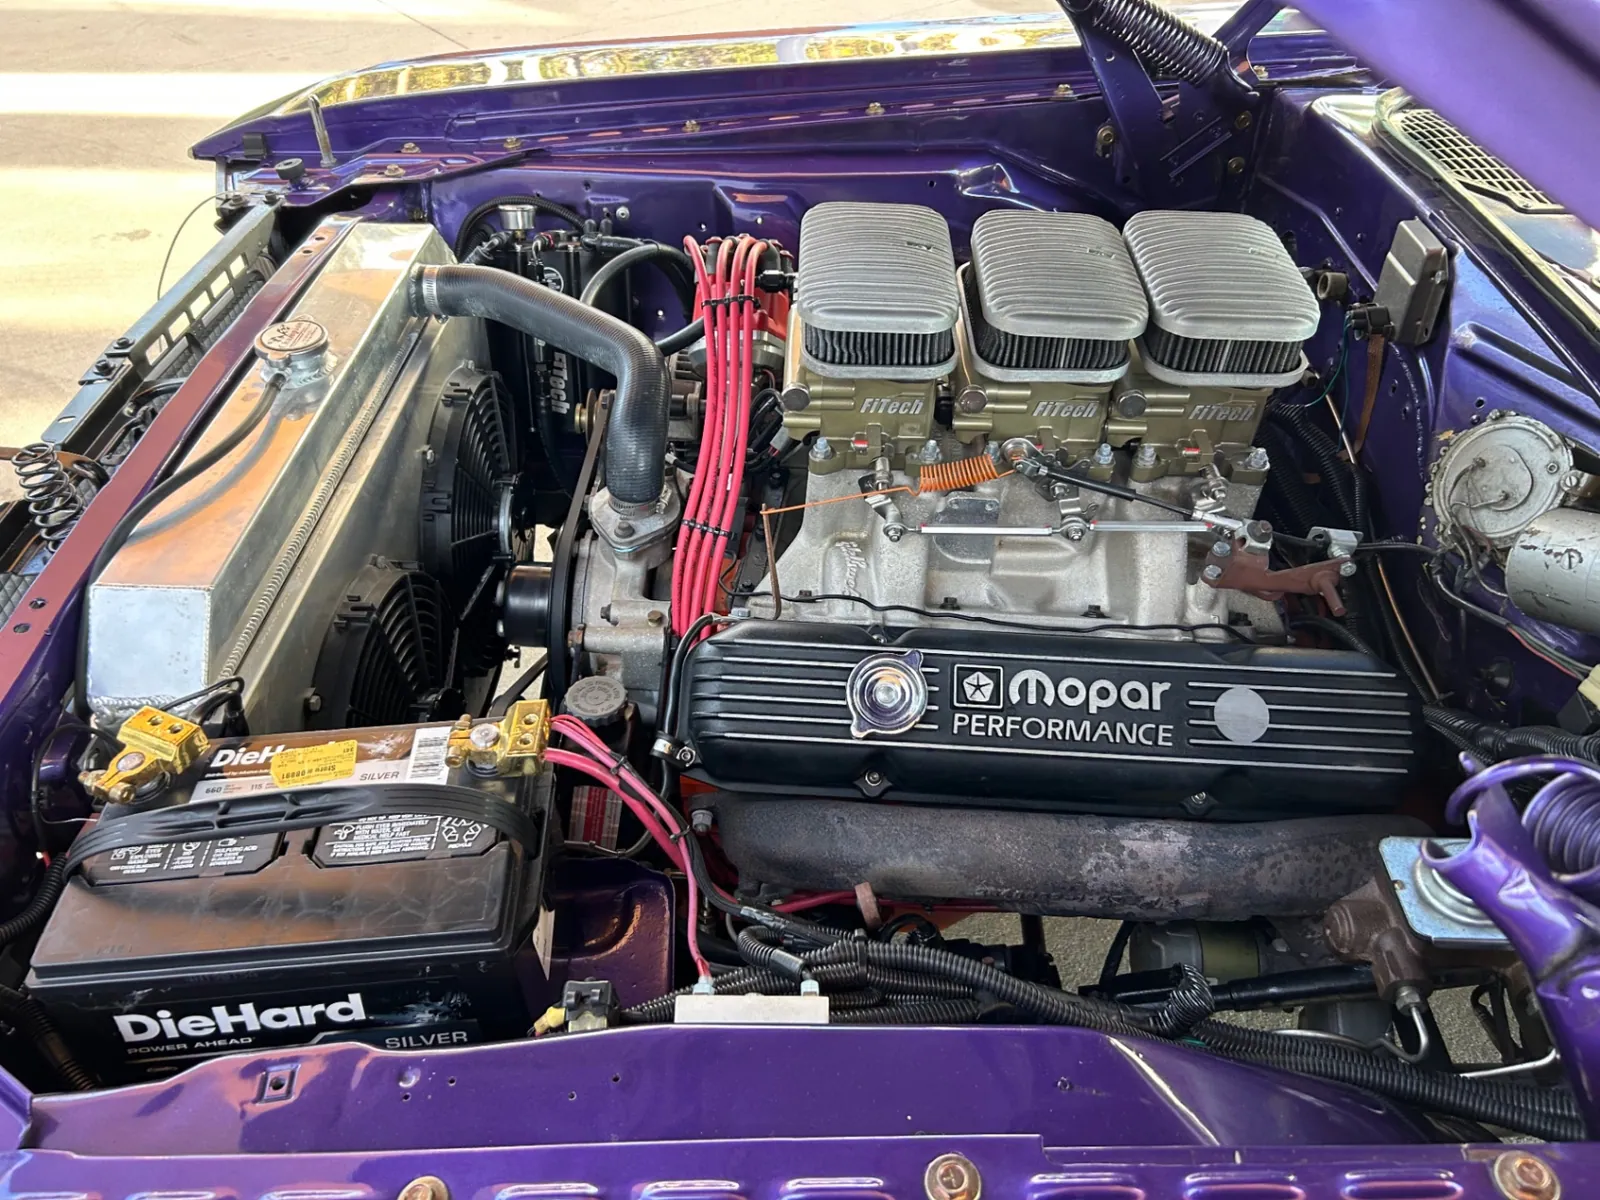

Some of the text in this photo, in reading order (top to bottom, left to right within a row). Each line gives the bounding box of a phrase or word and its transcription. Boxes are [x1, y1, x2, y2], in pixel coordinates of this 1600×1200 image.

[859, 398, 924, 415] FiTech
[1032, 401, 1099, 418] FiTech
[1188, 404, 1255, 421] FiTech
[952, 713, 1174, 746] PERFORMANCE
[360, 771, 400, 781] SILVER
[113, 993, 366, 1043] DieHard
[127, 1037, 253, 1055] POWER AHEAD
[385, 1031, 468, 1049] SILVER
